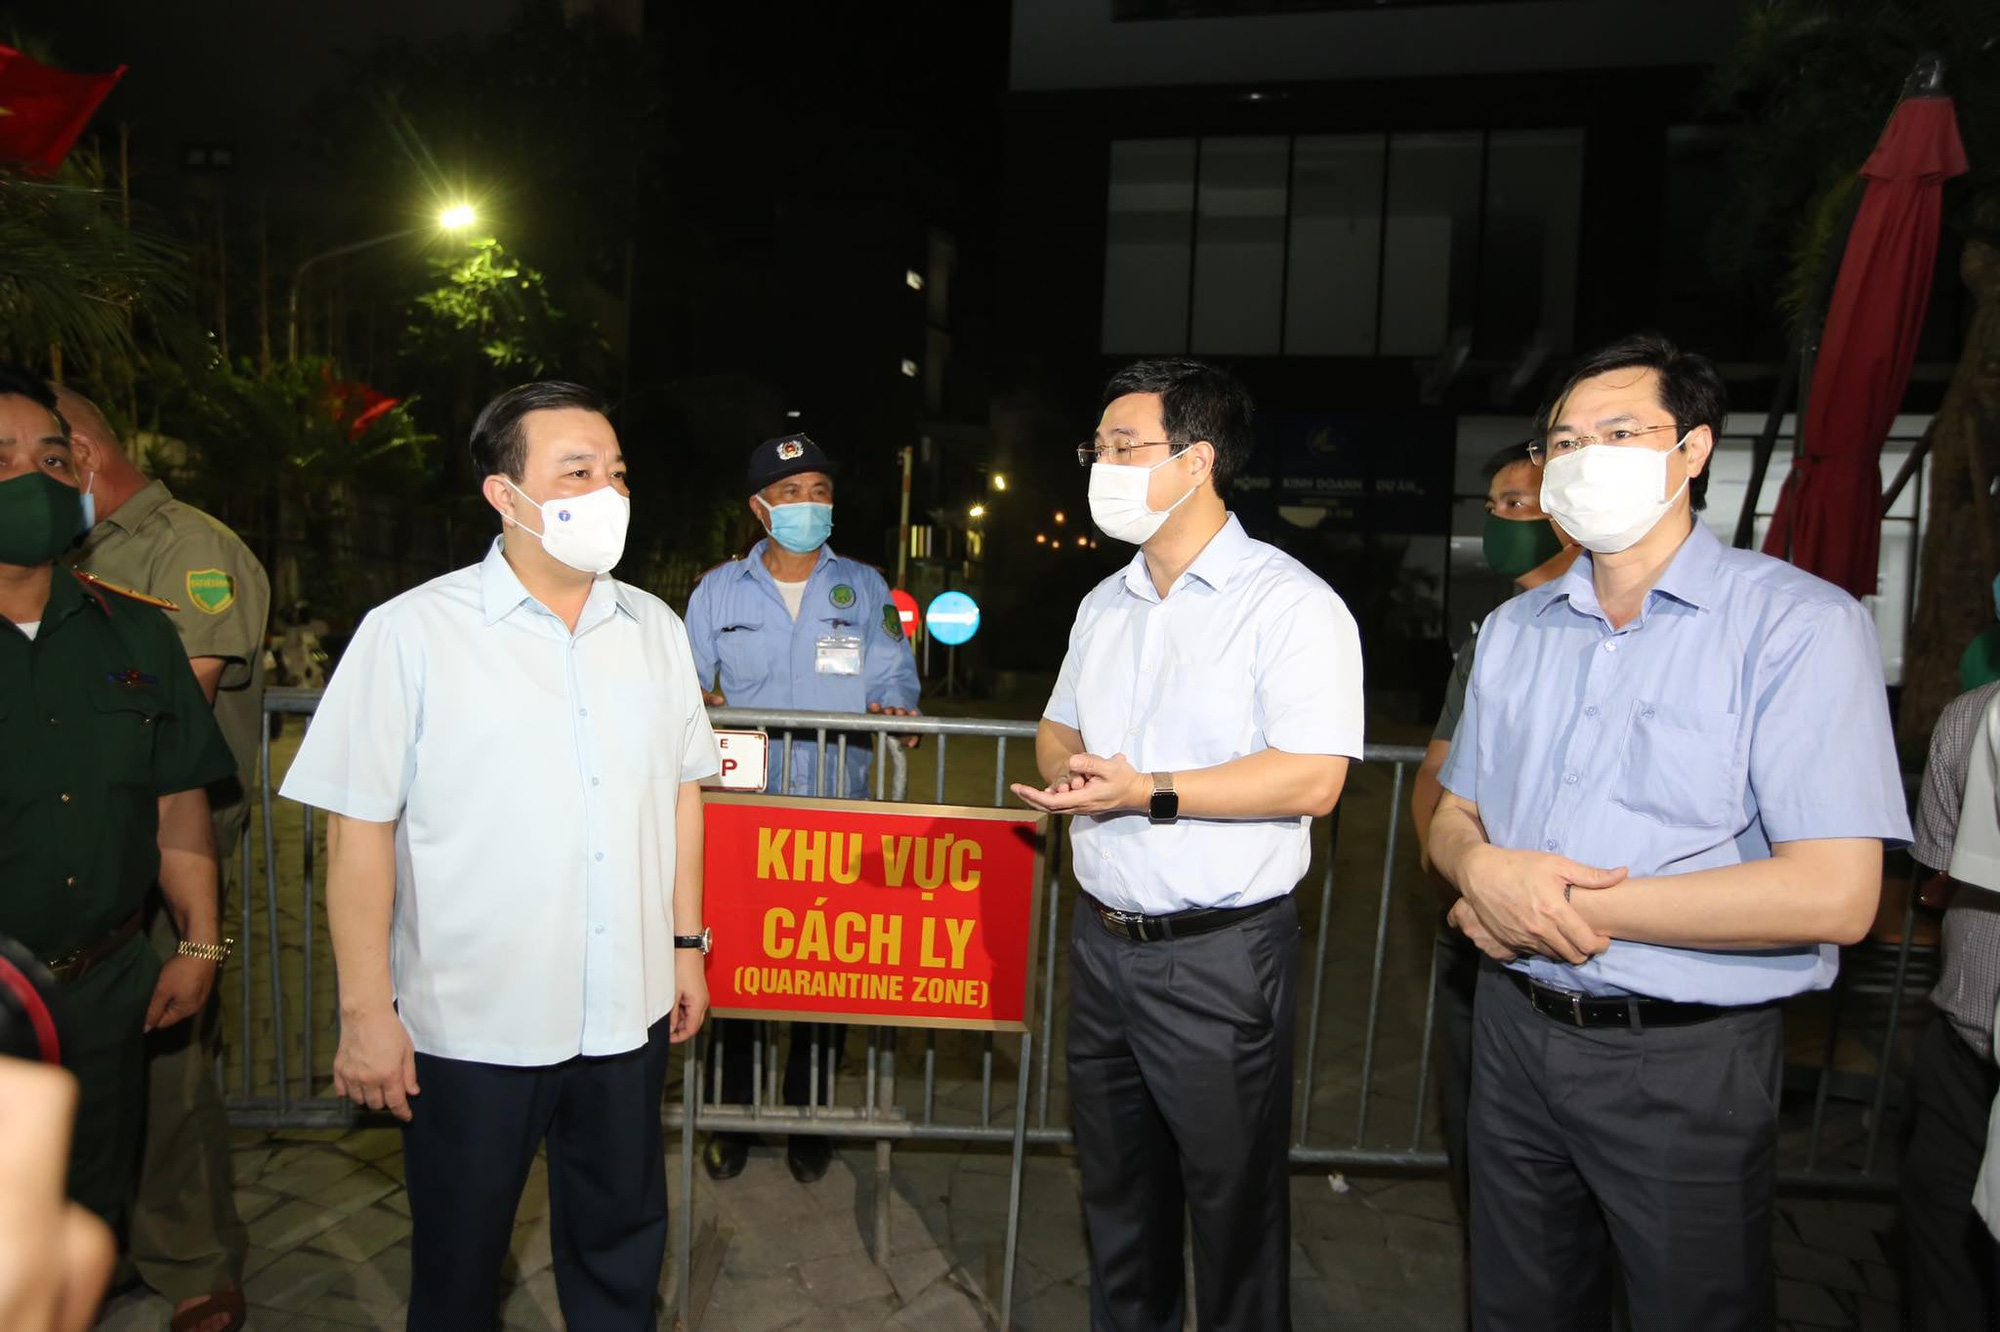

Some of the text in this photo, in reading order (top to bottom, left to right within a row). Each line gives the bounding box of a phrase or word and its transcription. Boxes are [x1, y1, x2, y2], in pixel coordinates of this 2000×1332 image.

[756, 827, 984, 902] KHU VỰC
[762, 896, 977, 970] CÁCH LY
[733, 966, 991, 1009] (QUARANTINE ZONE)
